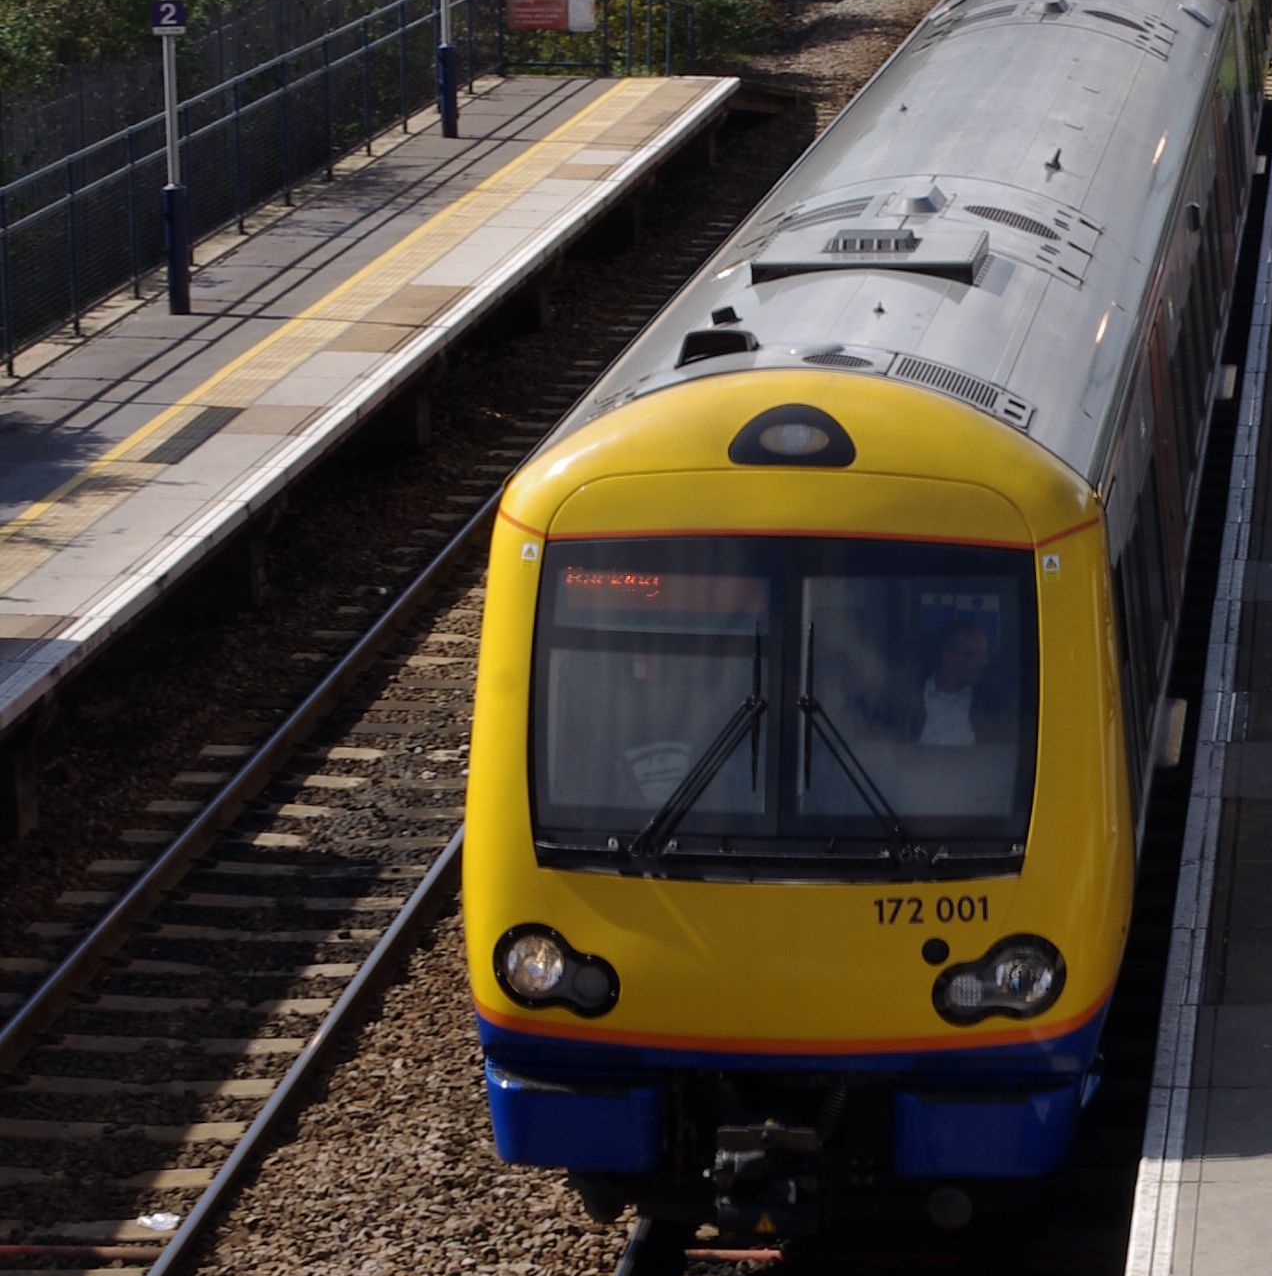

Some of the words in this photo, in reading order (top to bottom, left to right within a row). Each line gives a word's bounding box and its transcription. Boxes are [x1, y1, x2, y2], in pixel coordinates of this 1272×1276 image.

[160, 3, 178, 25] 2
[873, 897, 924, 925] 172
[936, 895, 989, 923] 001
